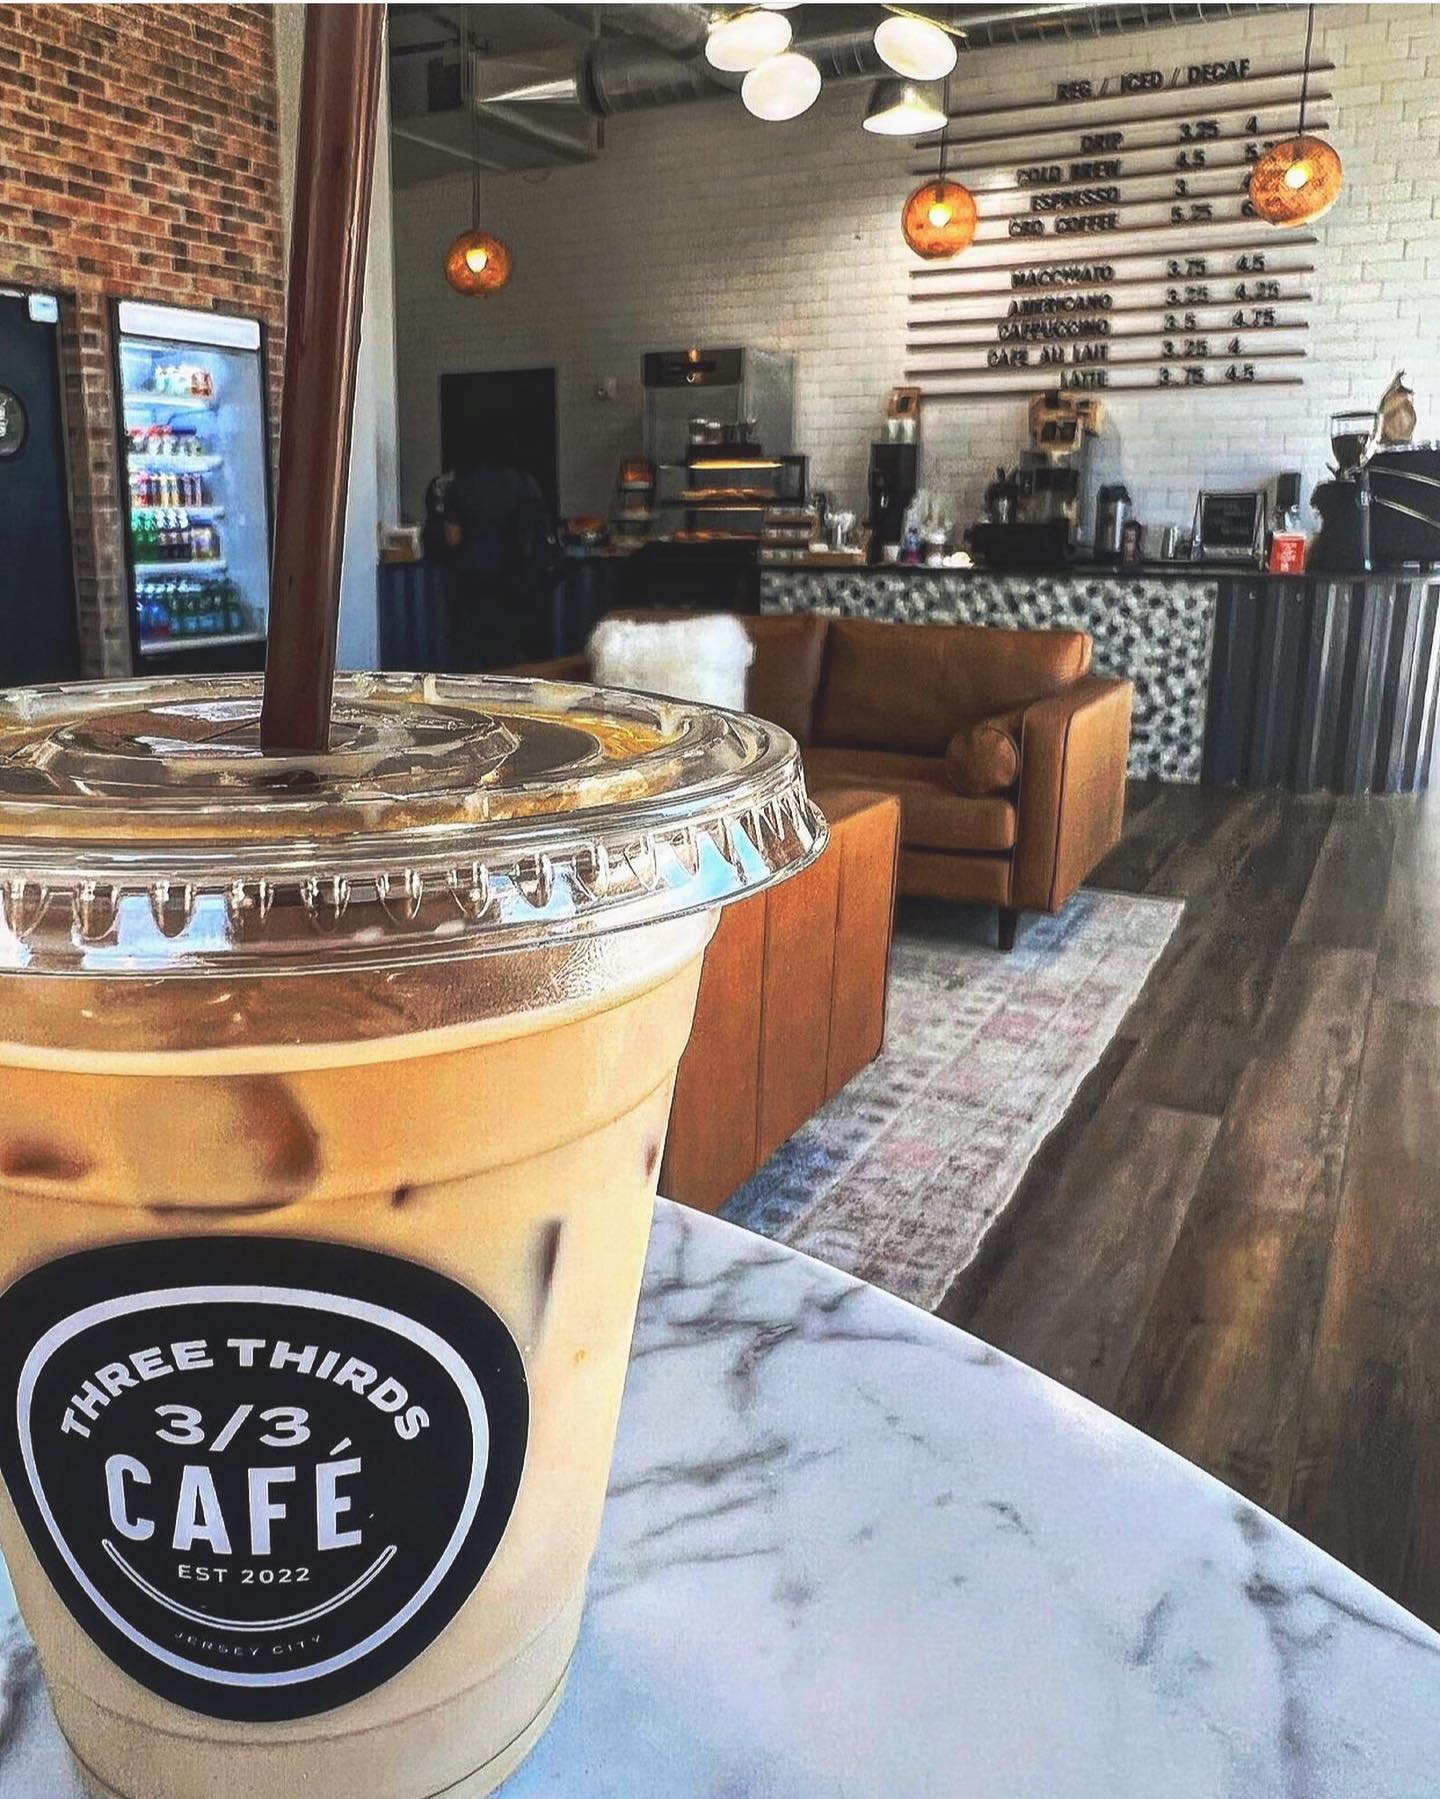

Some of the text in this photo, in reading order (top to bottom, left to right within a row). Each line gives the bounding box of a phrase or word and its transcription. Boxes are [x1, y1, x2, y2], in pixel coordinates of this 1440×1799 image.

[1120, 71, 1163, 94] ICED
[1188, 58, 1250, 84] DECAF
[1245, 115, 1258, 133] 4
[1016, 166, 1061, 186] COLD
[1030, 186, 1119, 212] ESPRESSO
[1055, 212, 1117, 234] COFFEE
[1007, 293, 1112, 317] AMERICANO
[1040, 345, 1065, 364] AU
[1060, 369, 1107, 389] LATTE
[61, 1338, 431, 1441] THREE THIRDS
[154, 1403, 312, 1452] 3/3
[104, 1437, 363, 1556] CAFÉ
[177, 1564, 311, 1584] EST 2022
[174, 1631, 321, 1657] JERSEY CITY
